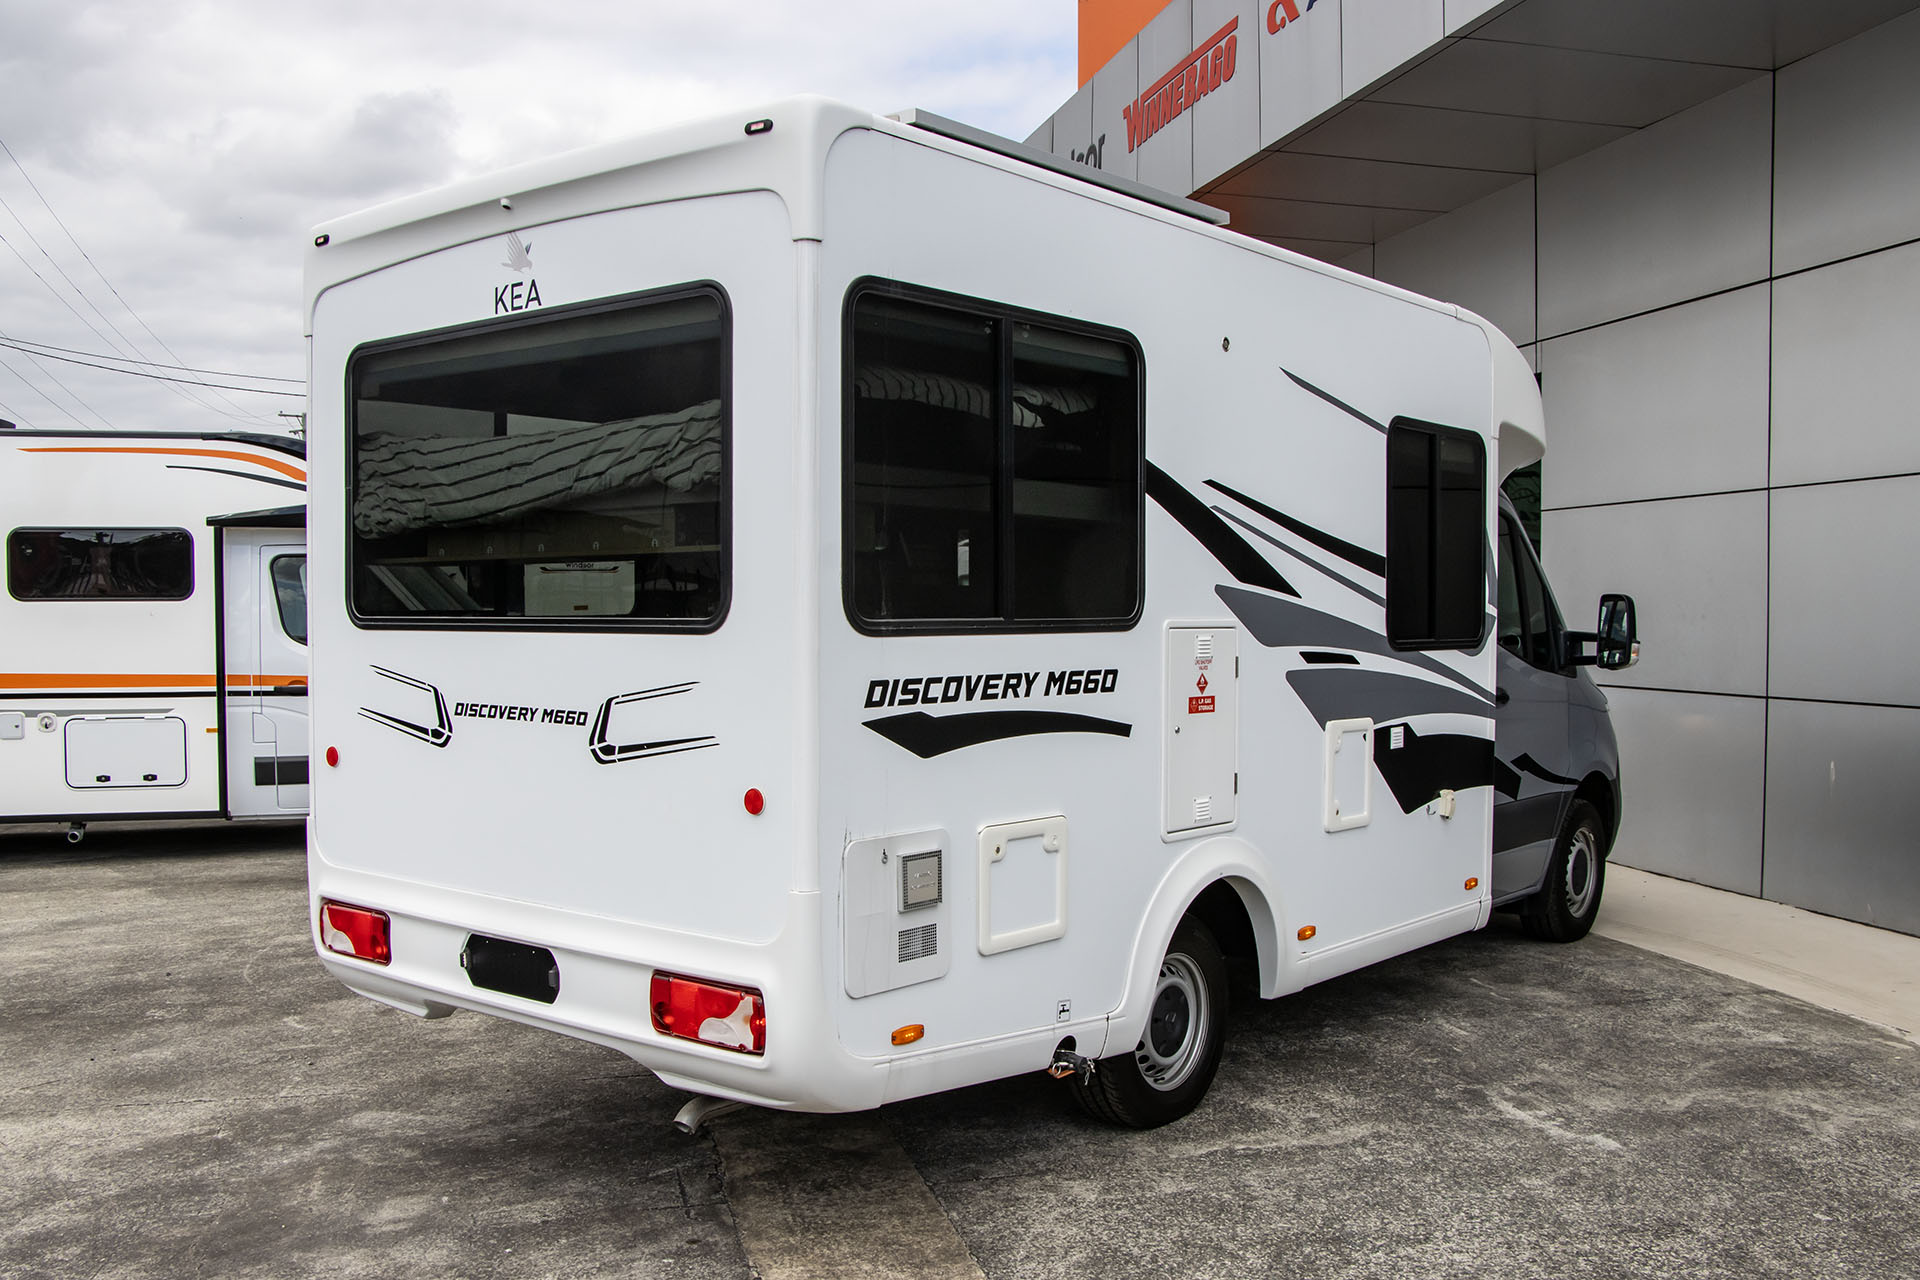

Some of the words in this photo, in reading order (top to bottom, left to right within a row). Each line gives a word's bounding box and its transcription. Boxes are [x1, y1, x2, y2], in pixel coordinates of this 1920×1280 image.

[1123, 34, 1237, 154] WINNEBAGO
[494, 279, 542, 315] KEA
[864, 671, 1040, 709] DISCOVERY
[1044, 668, 1119, 697] M660
[454, 702, 539, 722] DISCOVERY
[541, 708, 589, 726] M660
